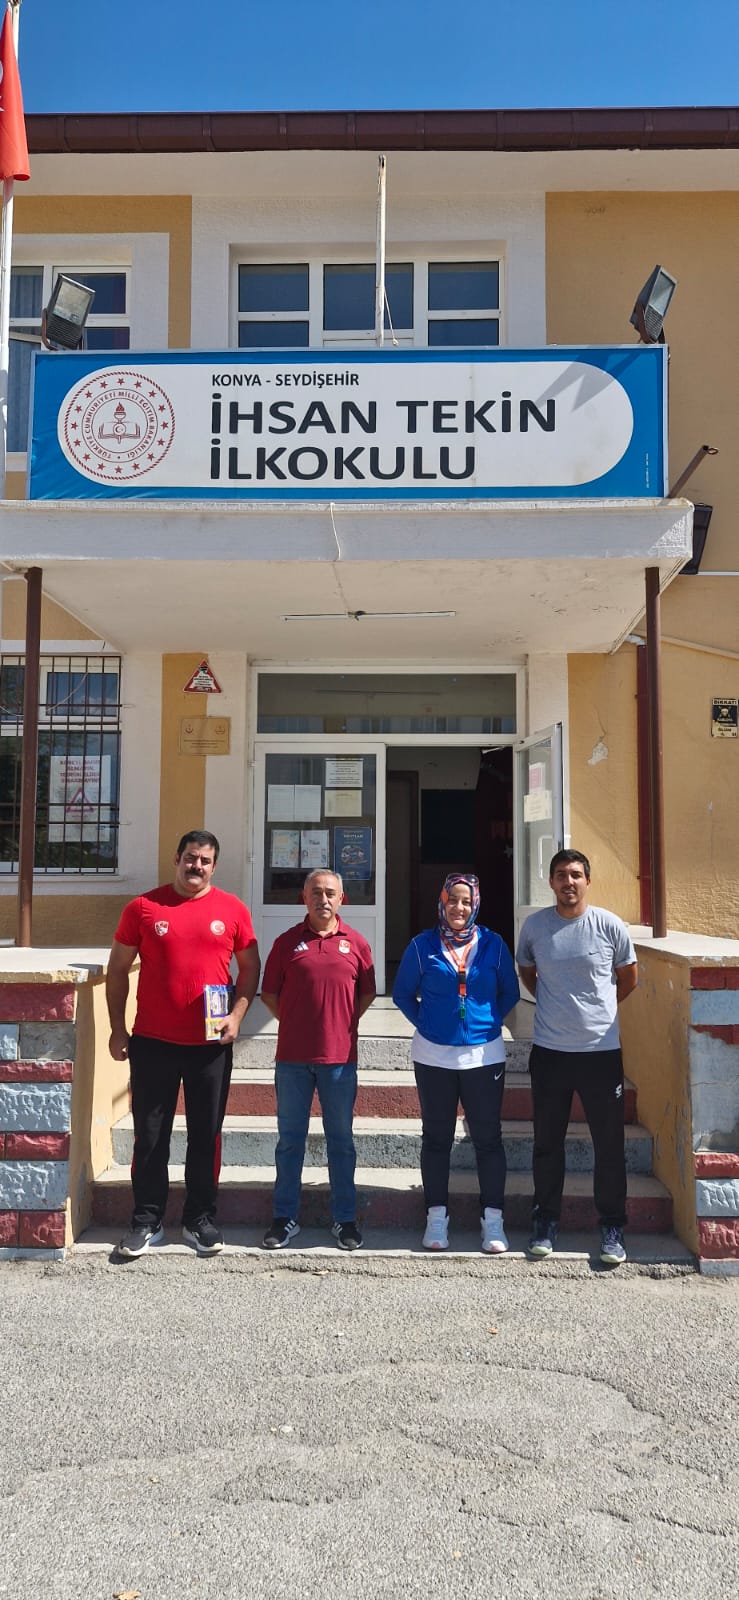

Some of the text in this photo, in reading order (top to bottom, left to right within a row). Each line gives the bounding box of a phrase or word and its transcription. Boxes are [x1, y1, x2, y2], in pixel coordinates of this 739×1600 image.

[211, 374, 262, 387] KONYA
[275, 371, 359, 389] SEYDİŞEHİR
[211, 391, 556, 434] İHSAN TEKİN
[210, 438, 476, 480] İLKOKULU
